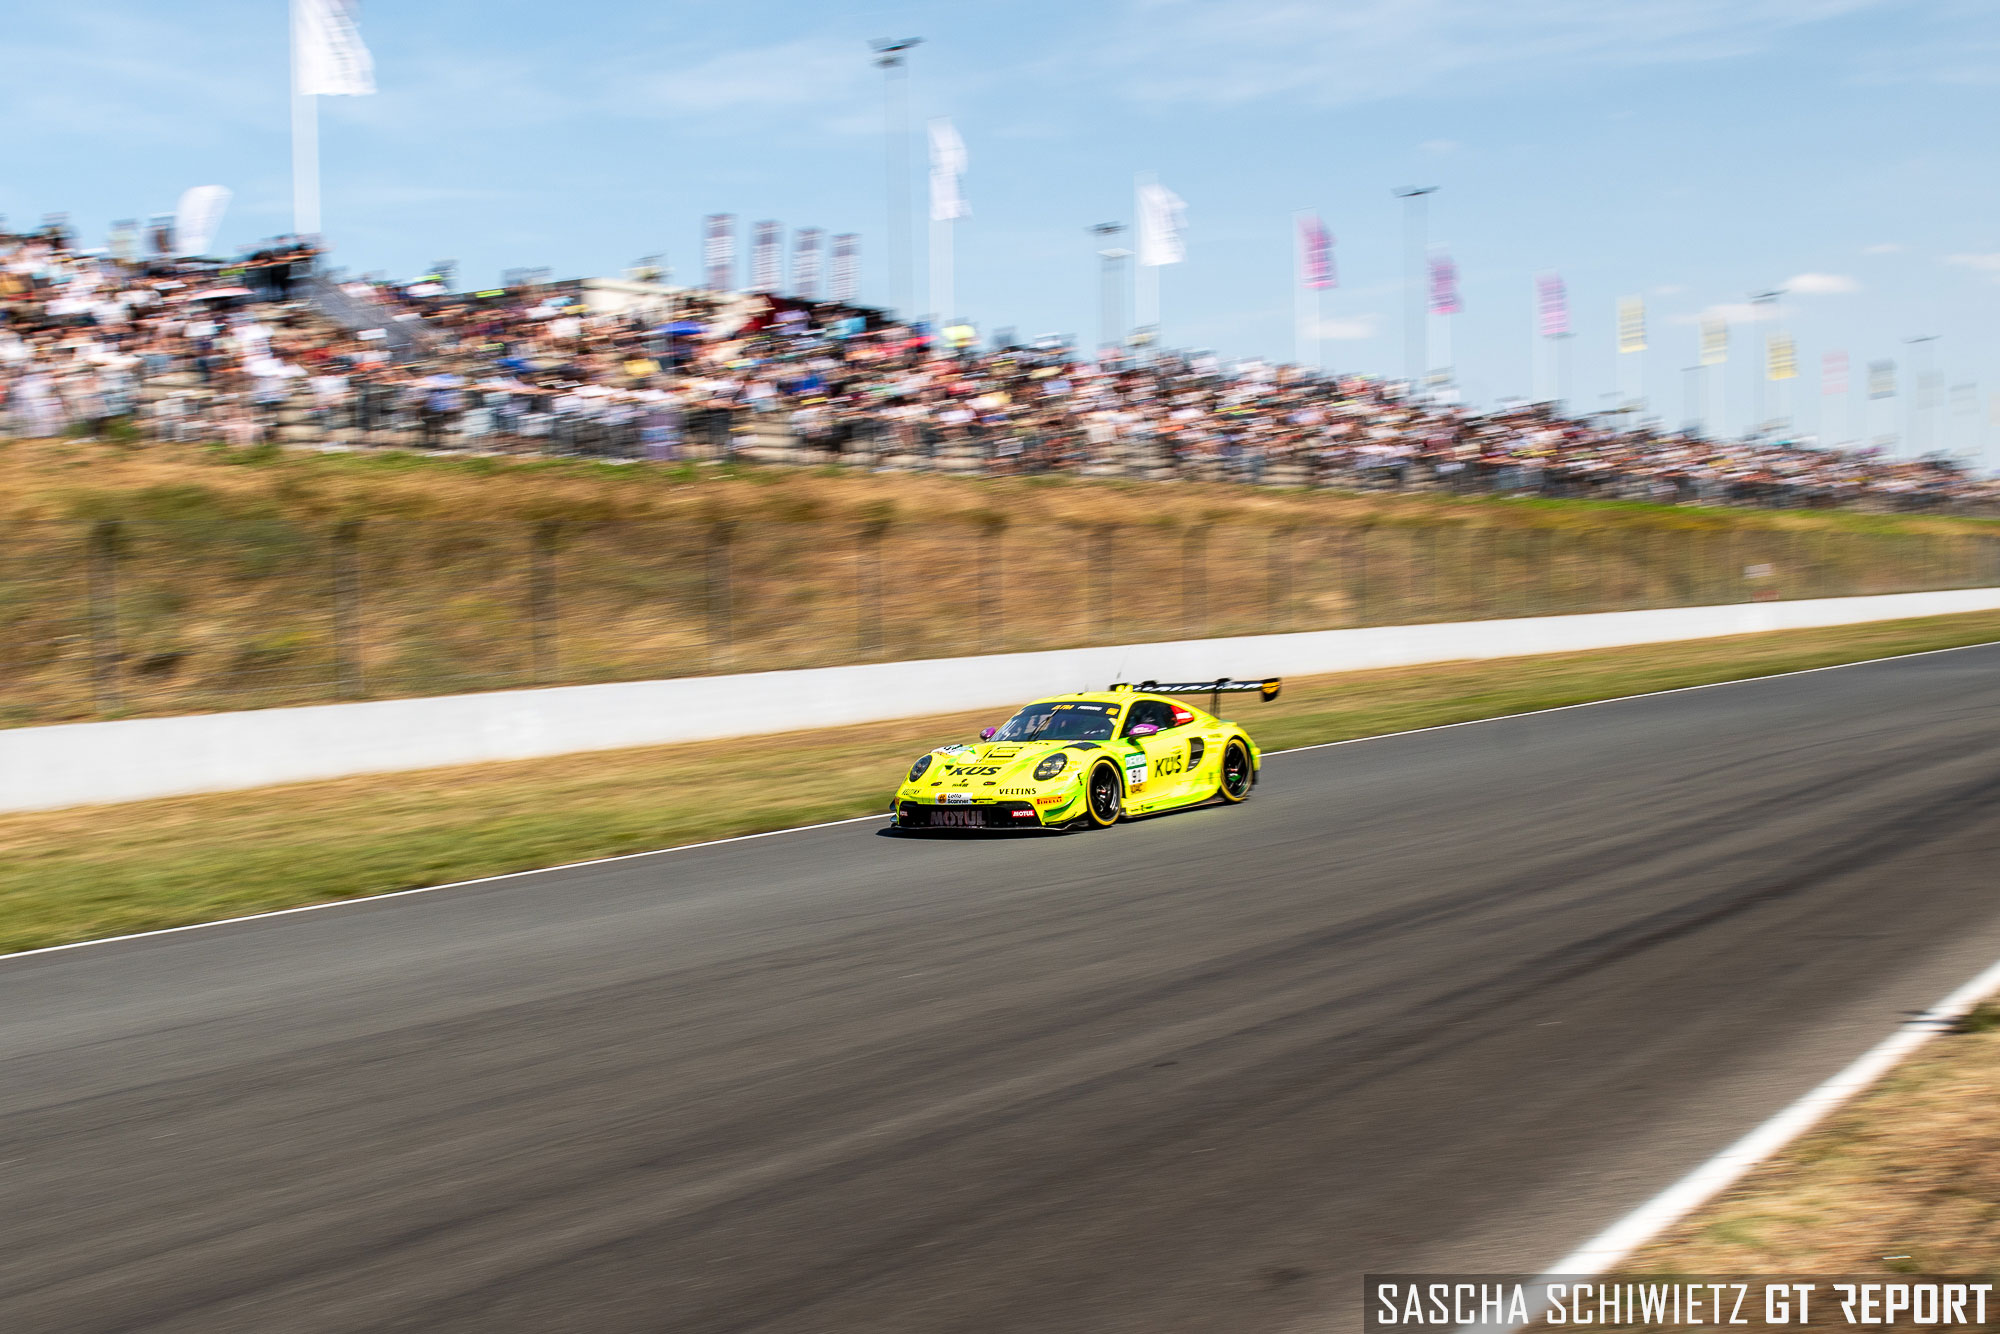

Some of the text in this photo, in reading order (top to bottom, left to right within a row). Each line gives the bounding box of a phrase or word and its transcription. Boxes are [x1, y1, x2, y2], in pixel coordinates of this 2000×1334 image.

[1131, 769, 1142, 783] 91
[999, 787, 1037, 795] VELTINS
[1036, 796, 1062, 805] PIRELLI
[1012, 809, 1034, 817] MOTUL
[930, 810, 986, 826] MOTUL
